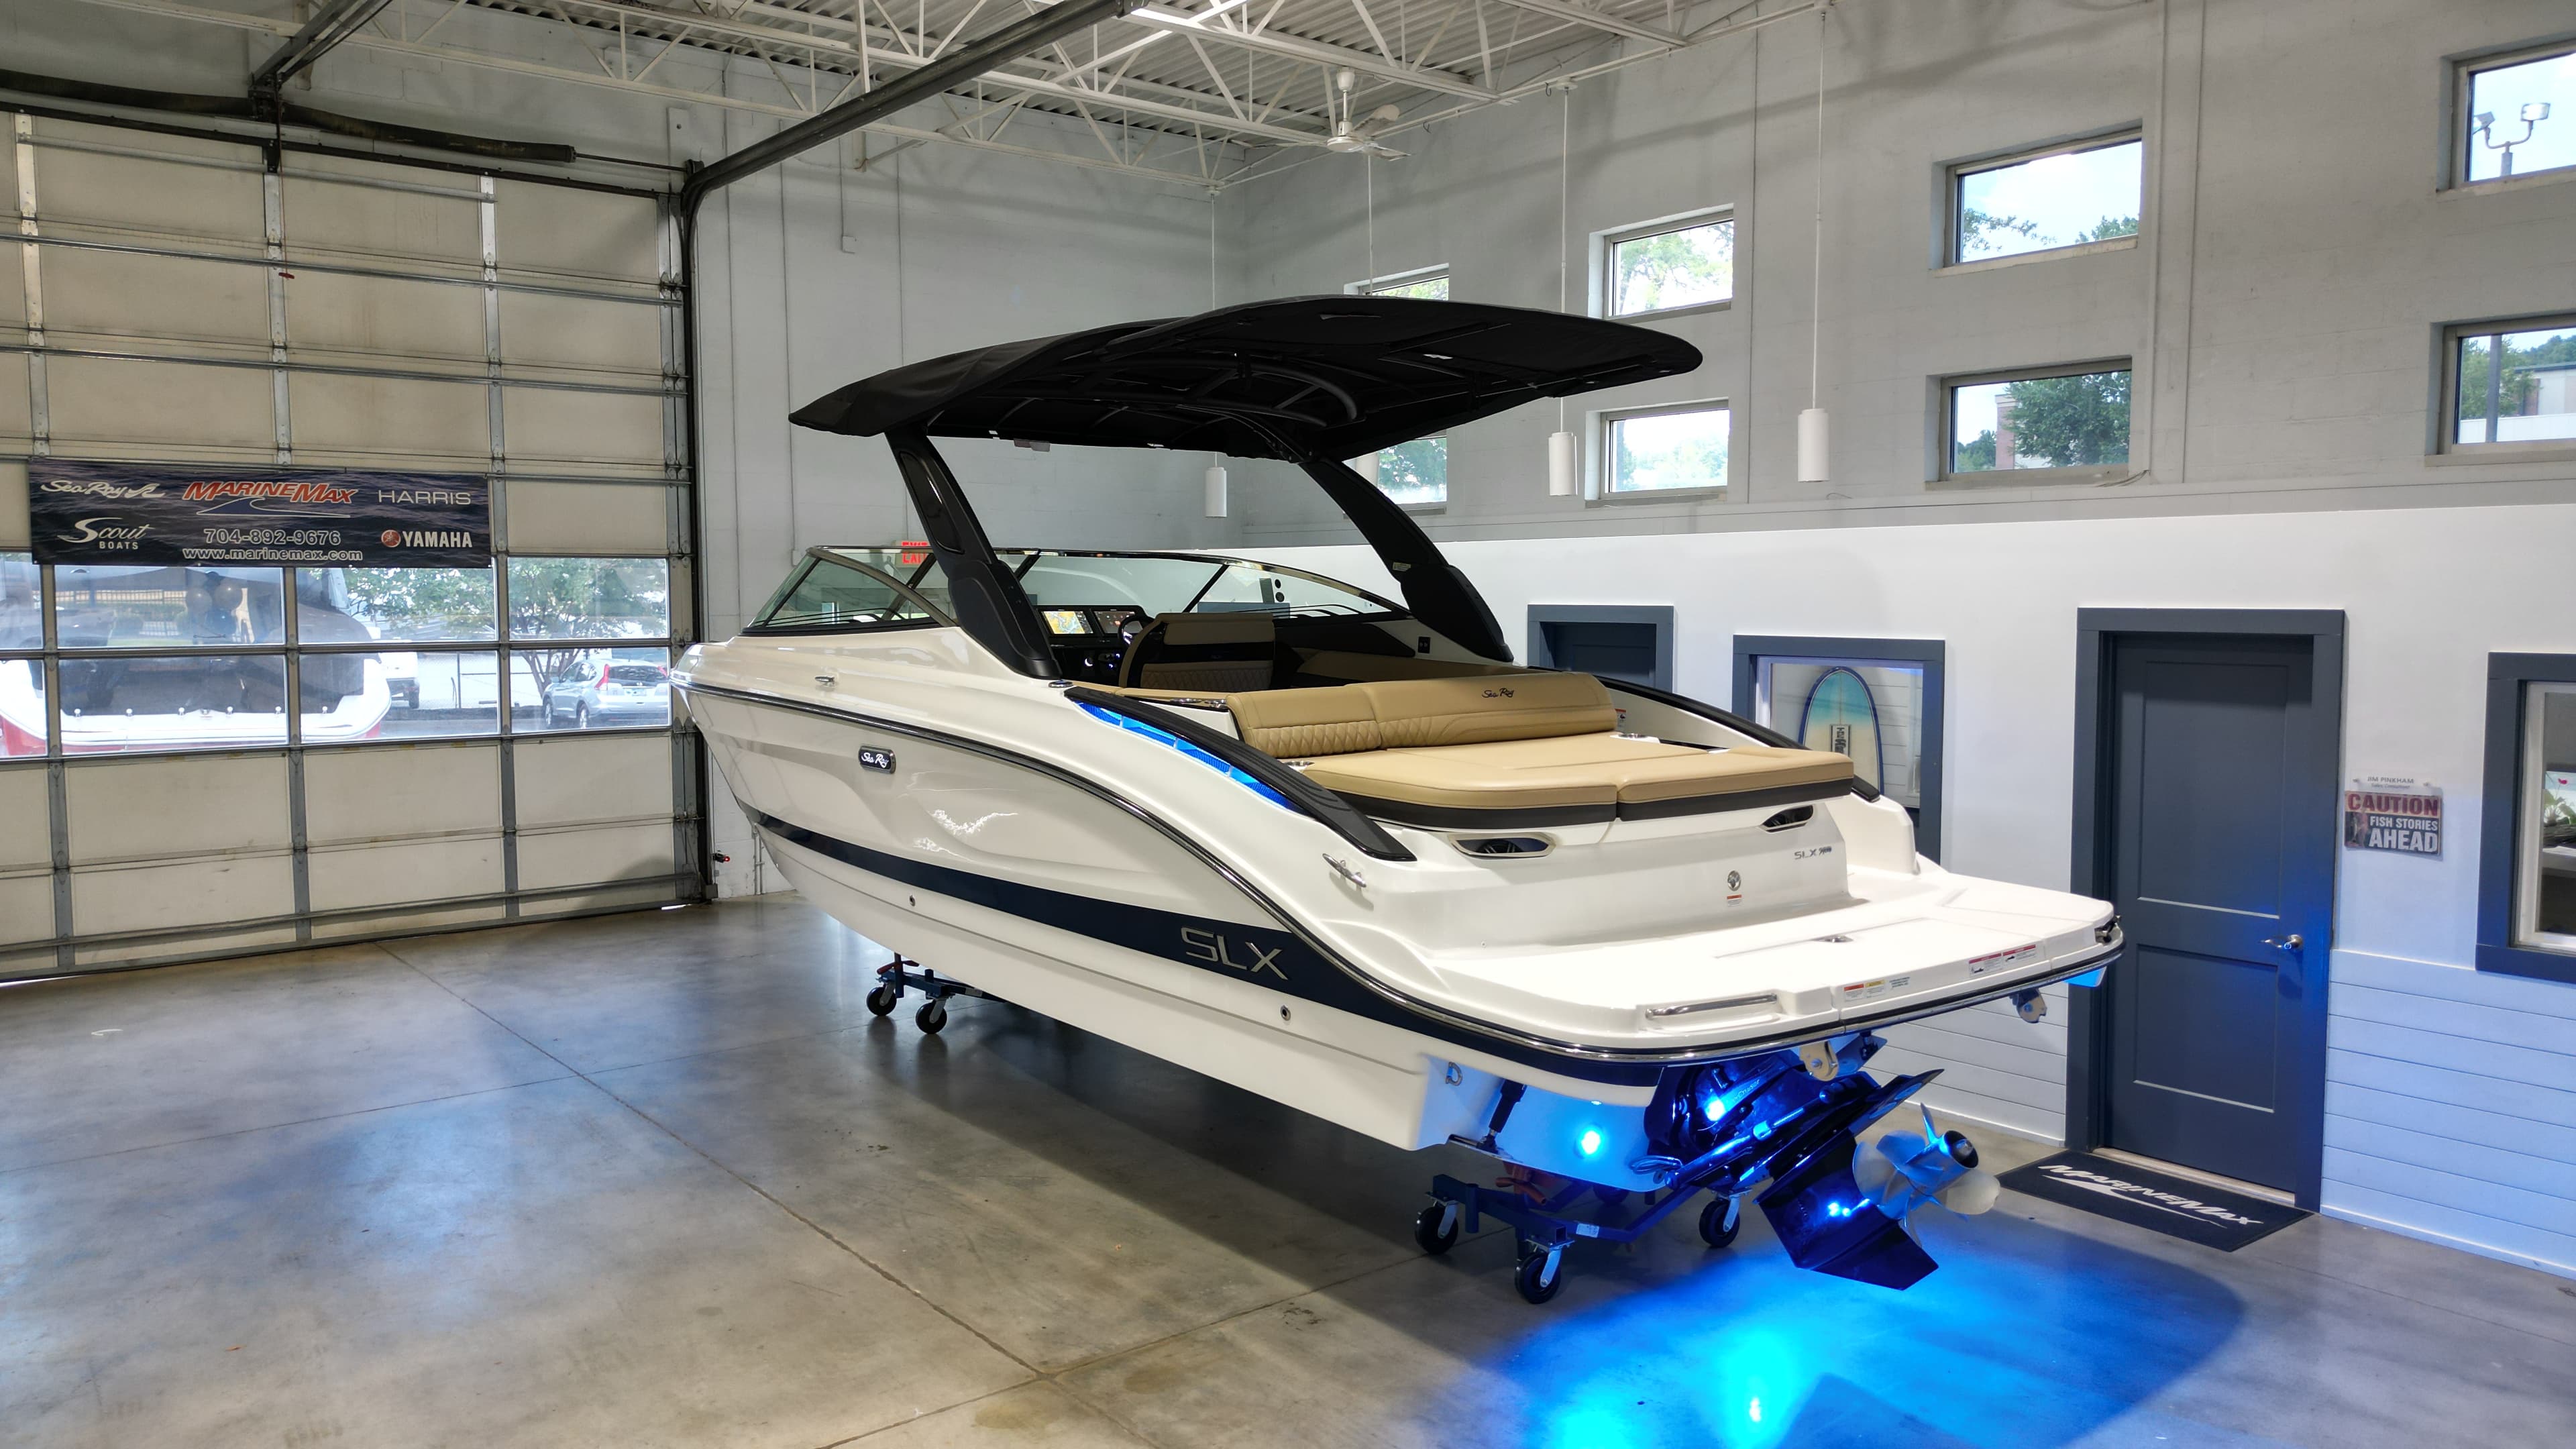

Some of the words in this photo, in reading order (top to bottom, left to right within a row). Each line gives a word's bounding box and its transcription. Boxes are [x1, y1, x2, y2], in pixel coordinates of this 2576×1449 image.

[40, 480, 87, 493] Sea
[85, 482, 127, 498] Ray
[378, 490, 472, 505] HARRIS
[57, 517, 156, 543] Scout
[204, 529, 341, 545] 704-892-9676
[99, 541, 138, 549] BOATS
[402, 531, 473, 547] YAMAHA
[182, 547, 363, 561] www.marinemax.com
[1481, 690, 1499, 698] Sea
[1499, 688, 1514, 698] Ray
[861, 752, 875, 763] Sea
[875, 753, 890, 768] Ray
[2348, 794, 2438, 816] CAUTION
[2369, 816, 2393, 828] FISH
[2396, 818, 2438, 831] STORIES
[2368, 828, 2438, 853] AHEAD
[1181, 927, 1288, 980] SLX
